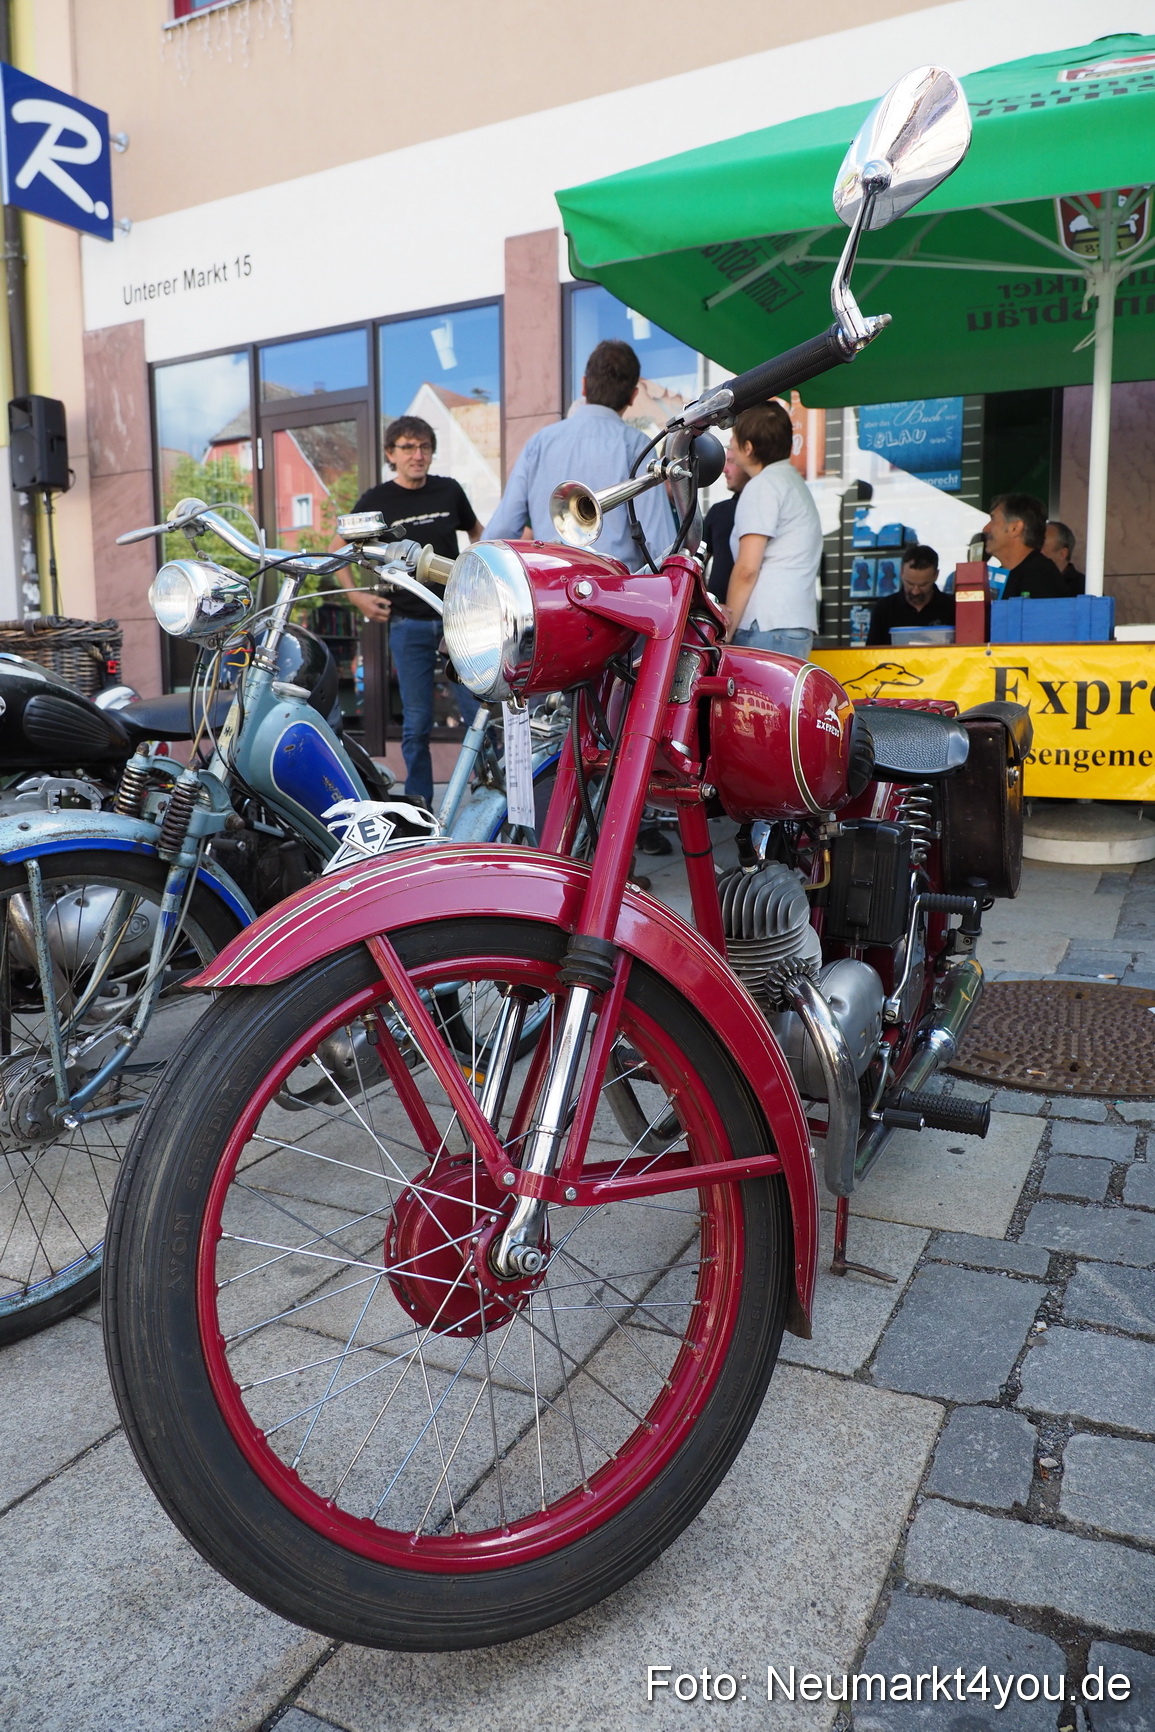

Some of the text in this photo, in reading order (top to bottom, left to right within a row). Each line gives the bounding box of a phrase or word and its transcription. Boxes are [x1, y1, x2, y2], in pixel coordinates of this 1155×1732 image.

[123, 254, 253, 306] Unterer Markt 15
[358, 818, 380, 844] E
